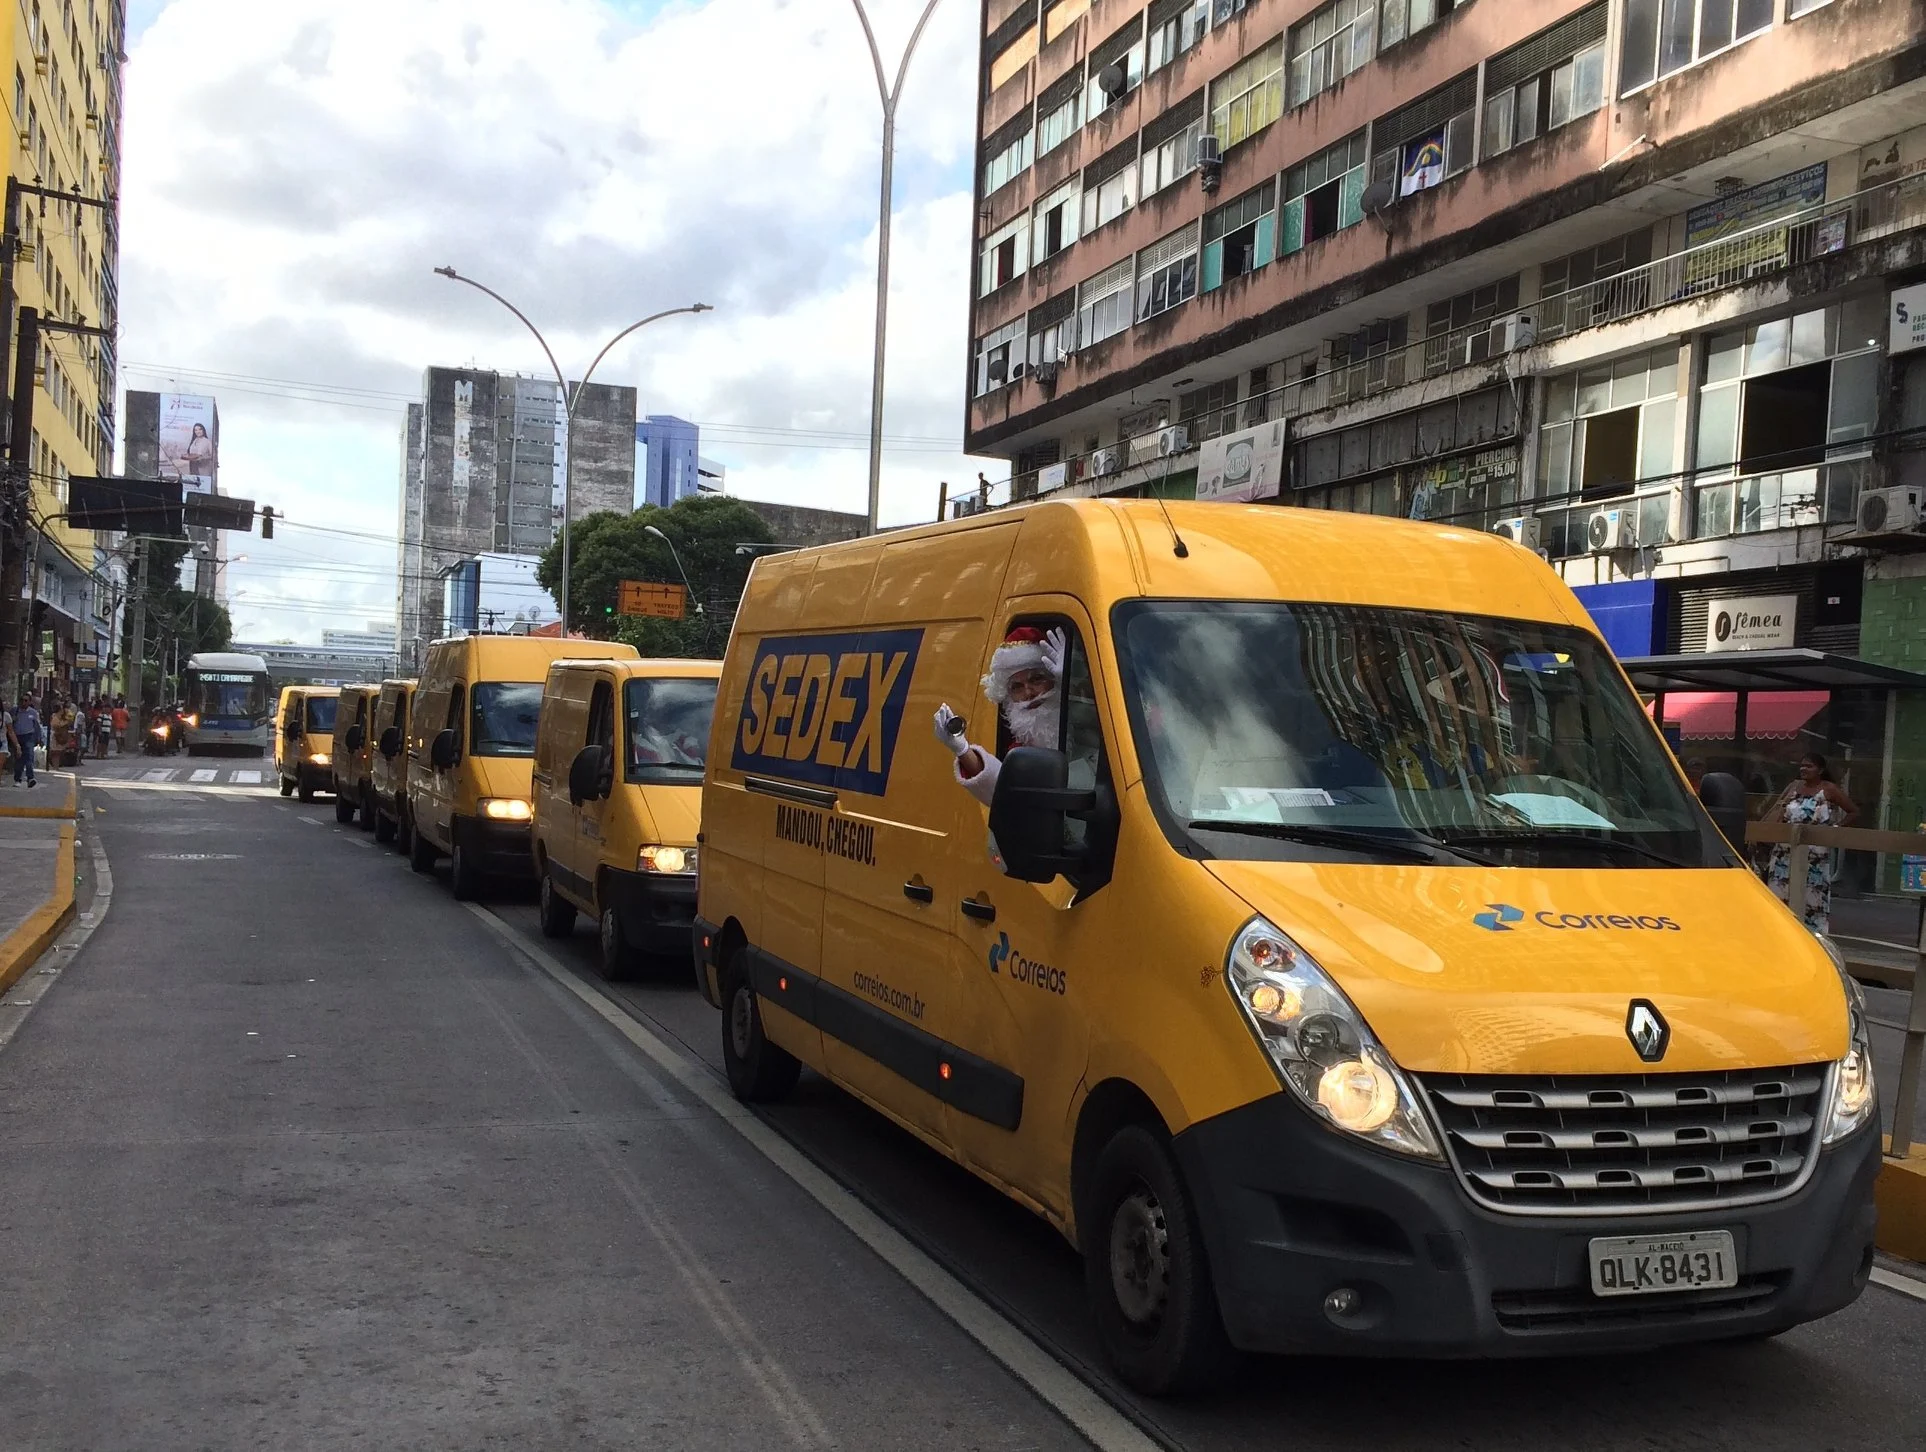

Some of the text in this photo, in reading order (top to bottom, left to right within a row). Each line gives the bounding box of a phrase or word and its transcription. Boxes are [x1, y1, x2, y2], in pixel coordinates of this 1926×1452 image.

[1475, 446, 1517, 466] PIERCING
[1732, 611, 1782, 634] fêmea
[741, 652, 908, 774] SEDEX
[776, 804, 876, 867] MANDOU, CHEGOU.
[1535, 911, 1681, 931] Correios
[853, 970, 926, 1020] correios.com.br
[1009, 950, 1066, 995] Correios
